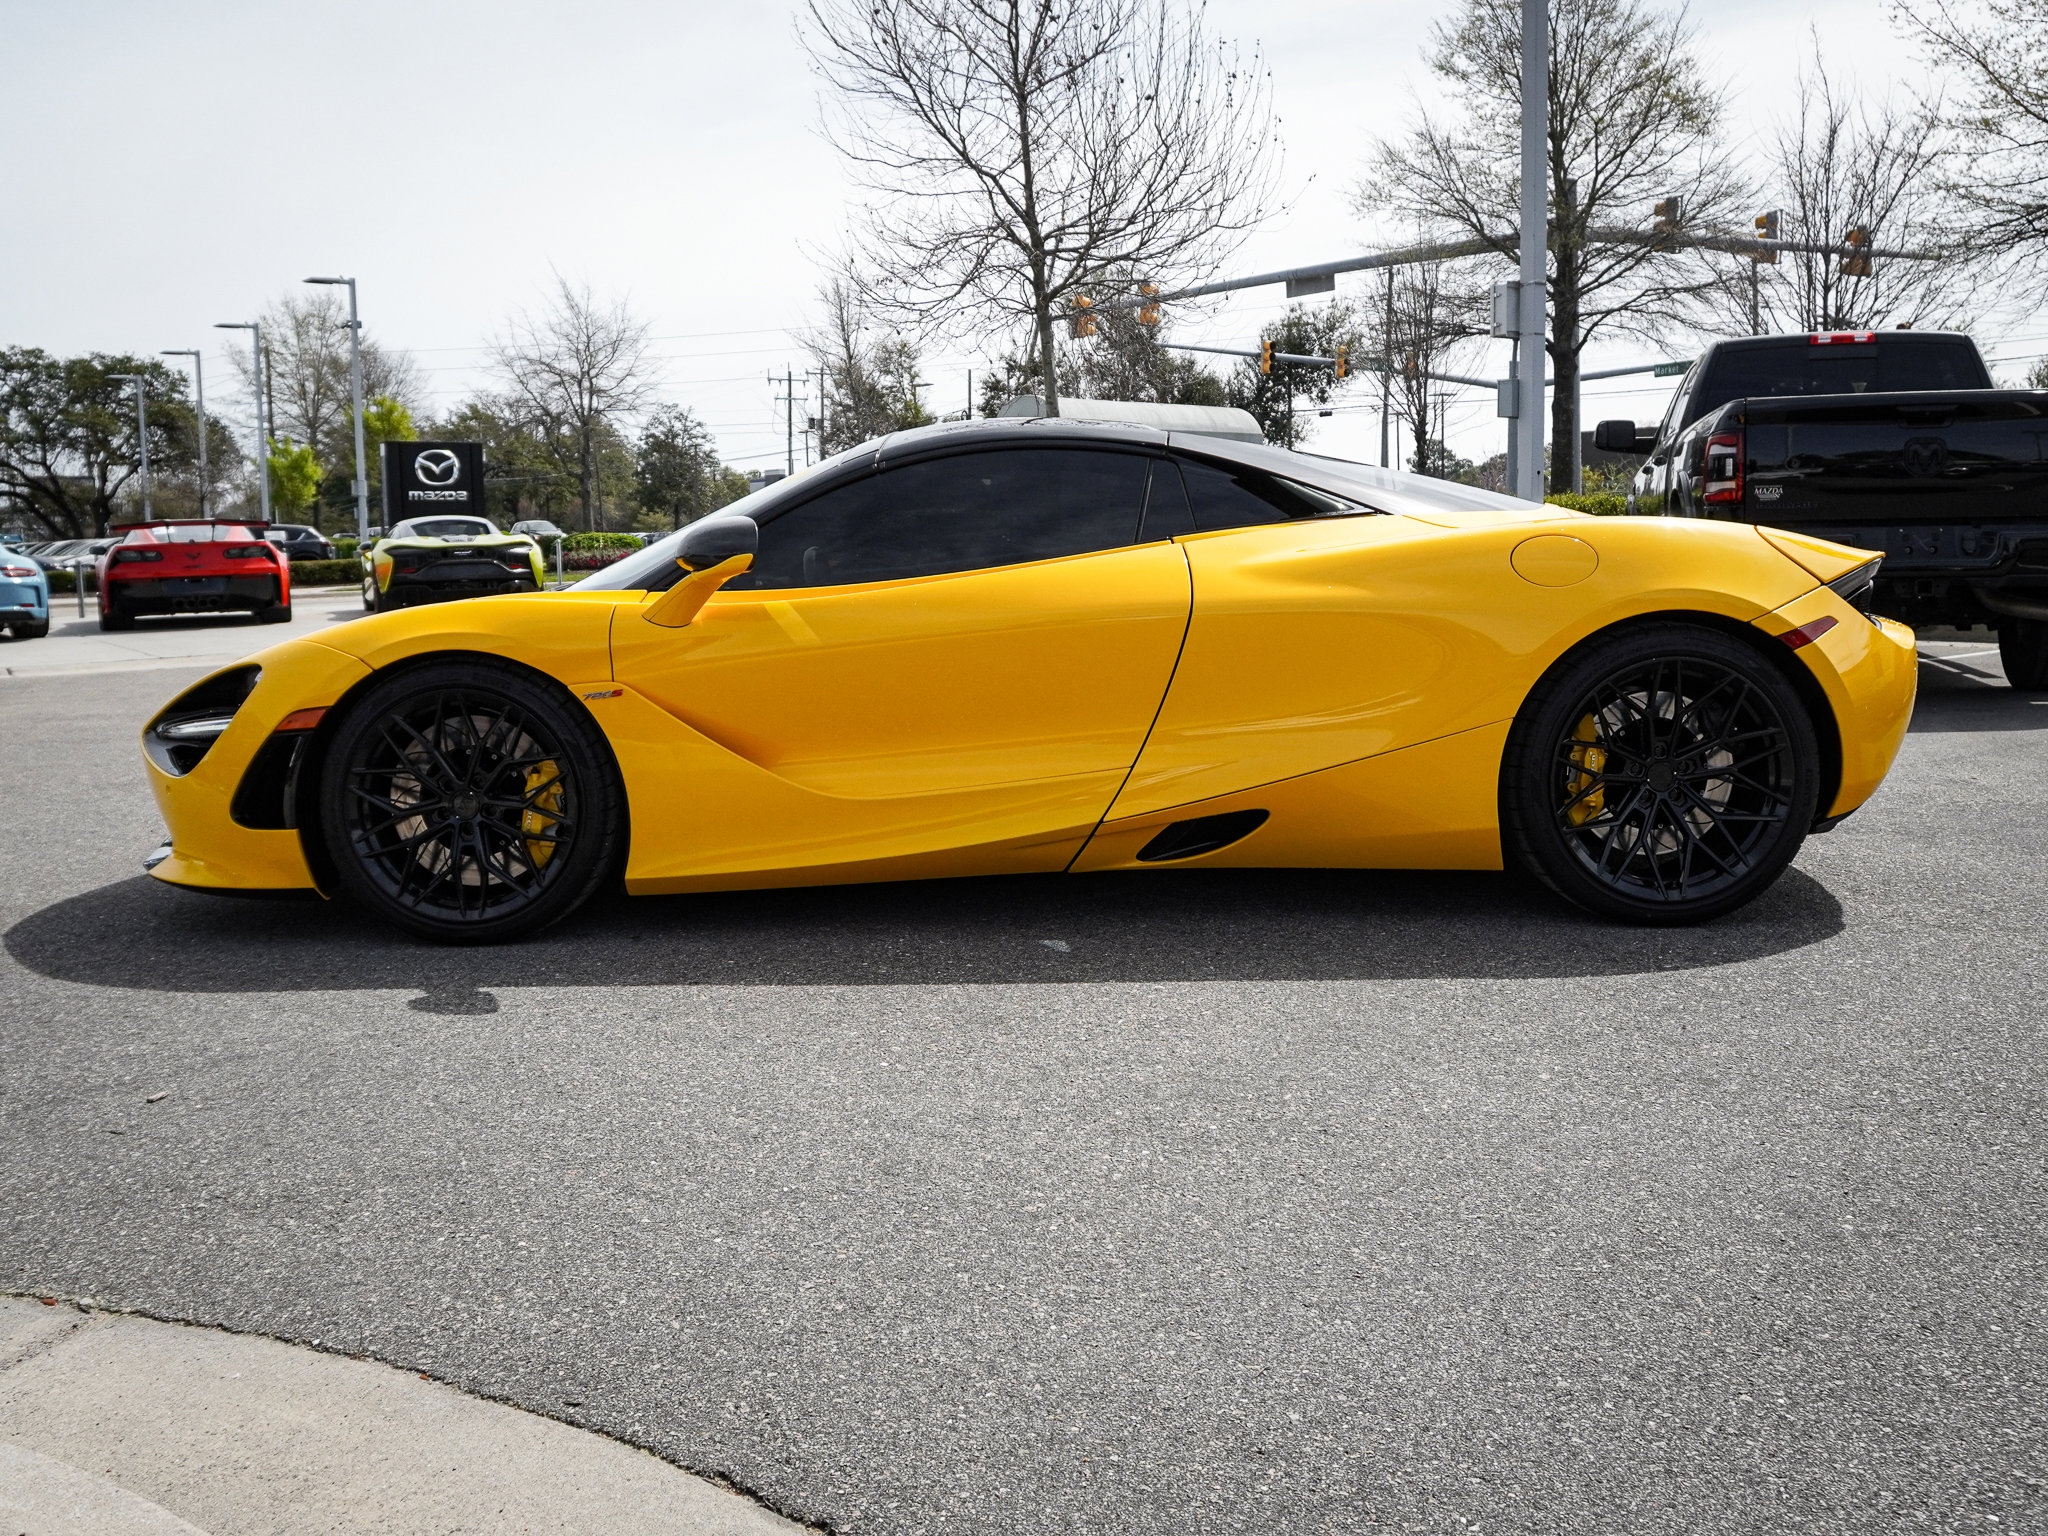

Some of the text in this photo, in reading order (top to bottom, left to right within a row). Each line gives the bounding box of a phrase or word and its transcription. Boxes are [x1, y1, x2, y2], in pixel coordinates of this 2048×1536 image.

[1655, 365, 1679, 375] Market
[1754, 487, 1783, 495] MAZDA
[582, 689, 624, 701] 720S
